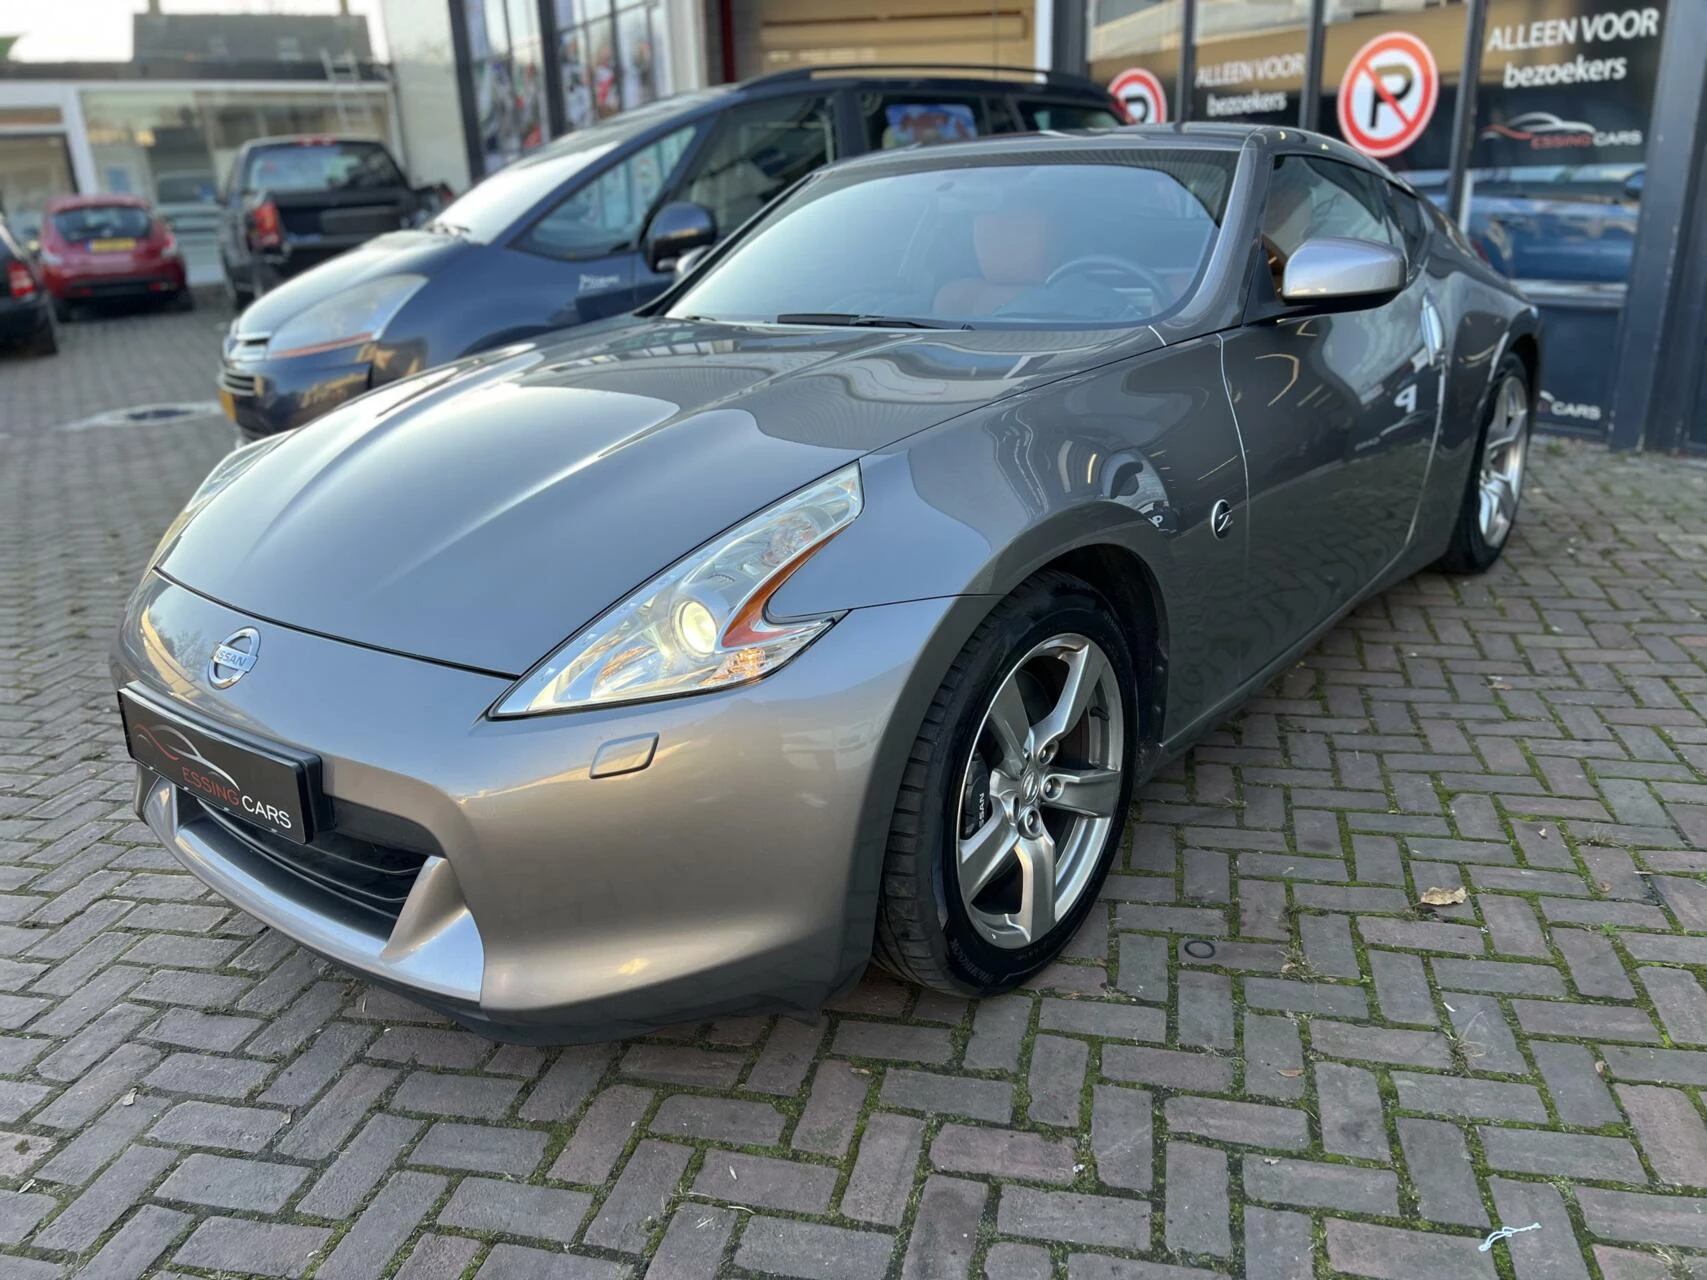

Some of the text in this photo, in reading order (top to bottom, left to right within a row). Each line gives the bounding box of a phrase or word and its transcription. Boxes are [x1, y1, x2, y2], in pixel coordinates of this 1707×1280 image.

[1487, 8, 1660, 52] ALLEEN VOOR
[1503, 54, 1627, 89] bezoekers
[216, 648, 247, 667] SSAN
